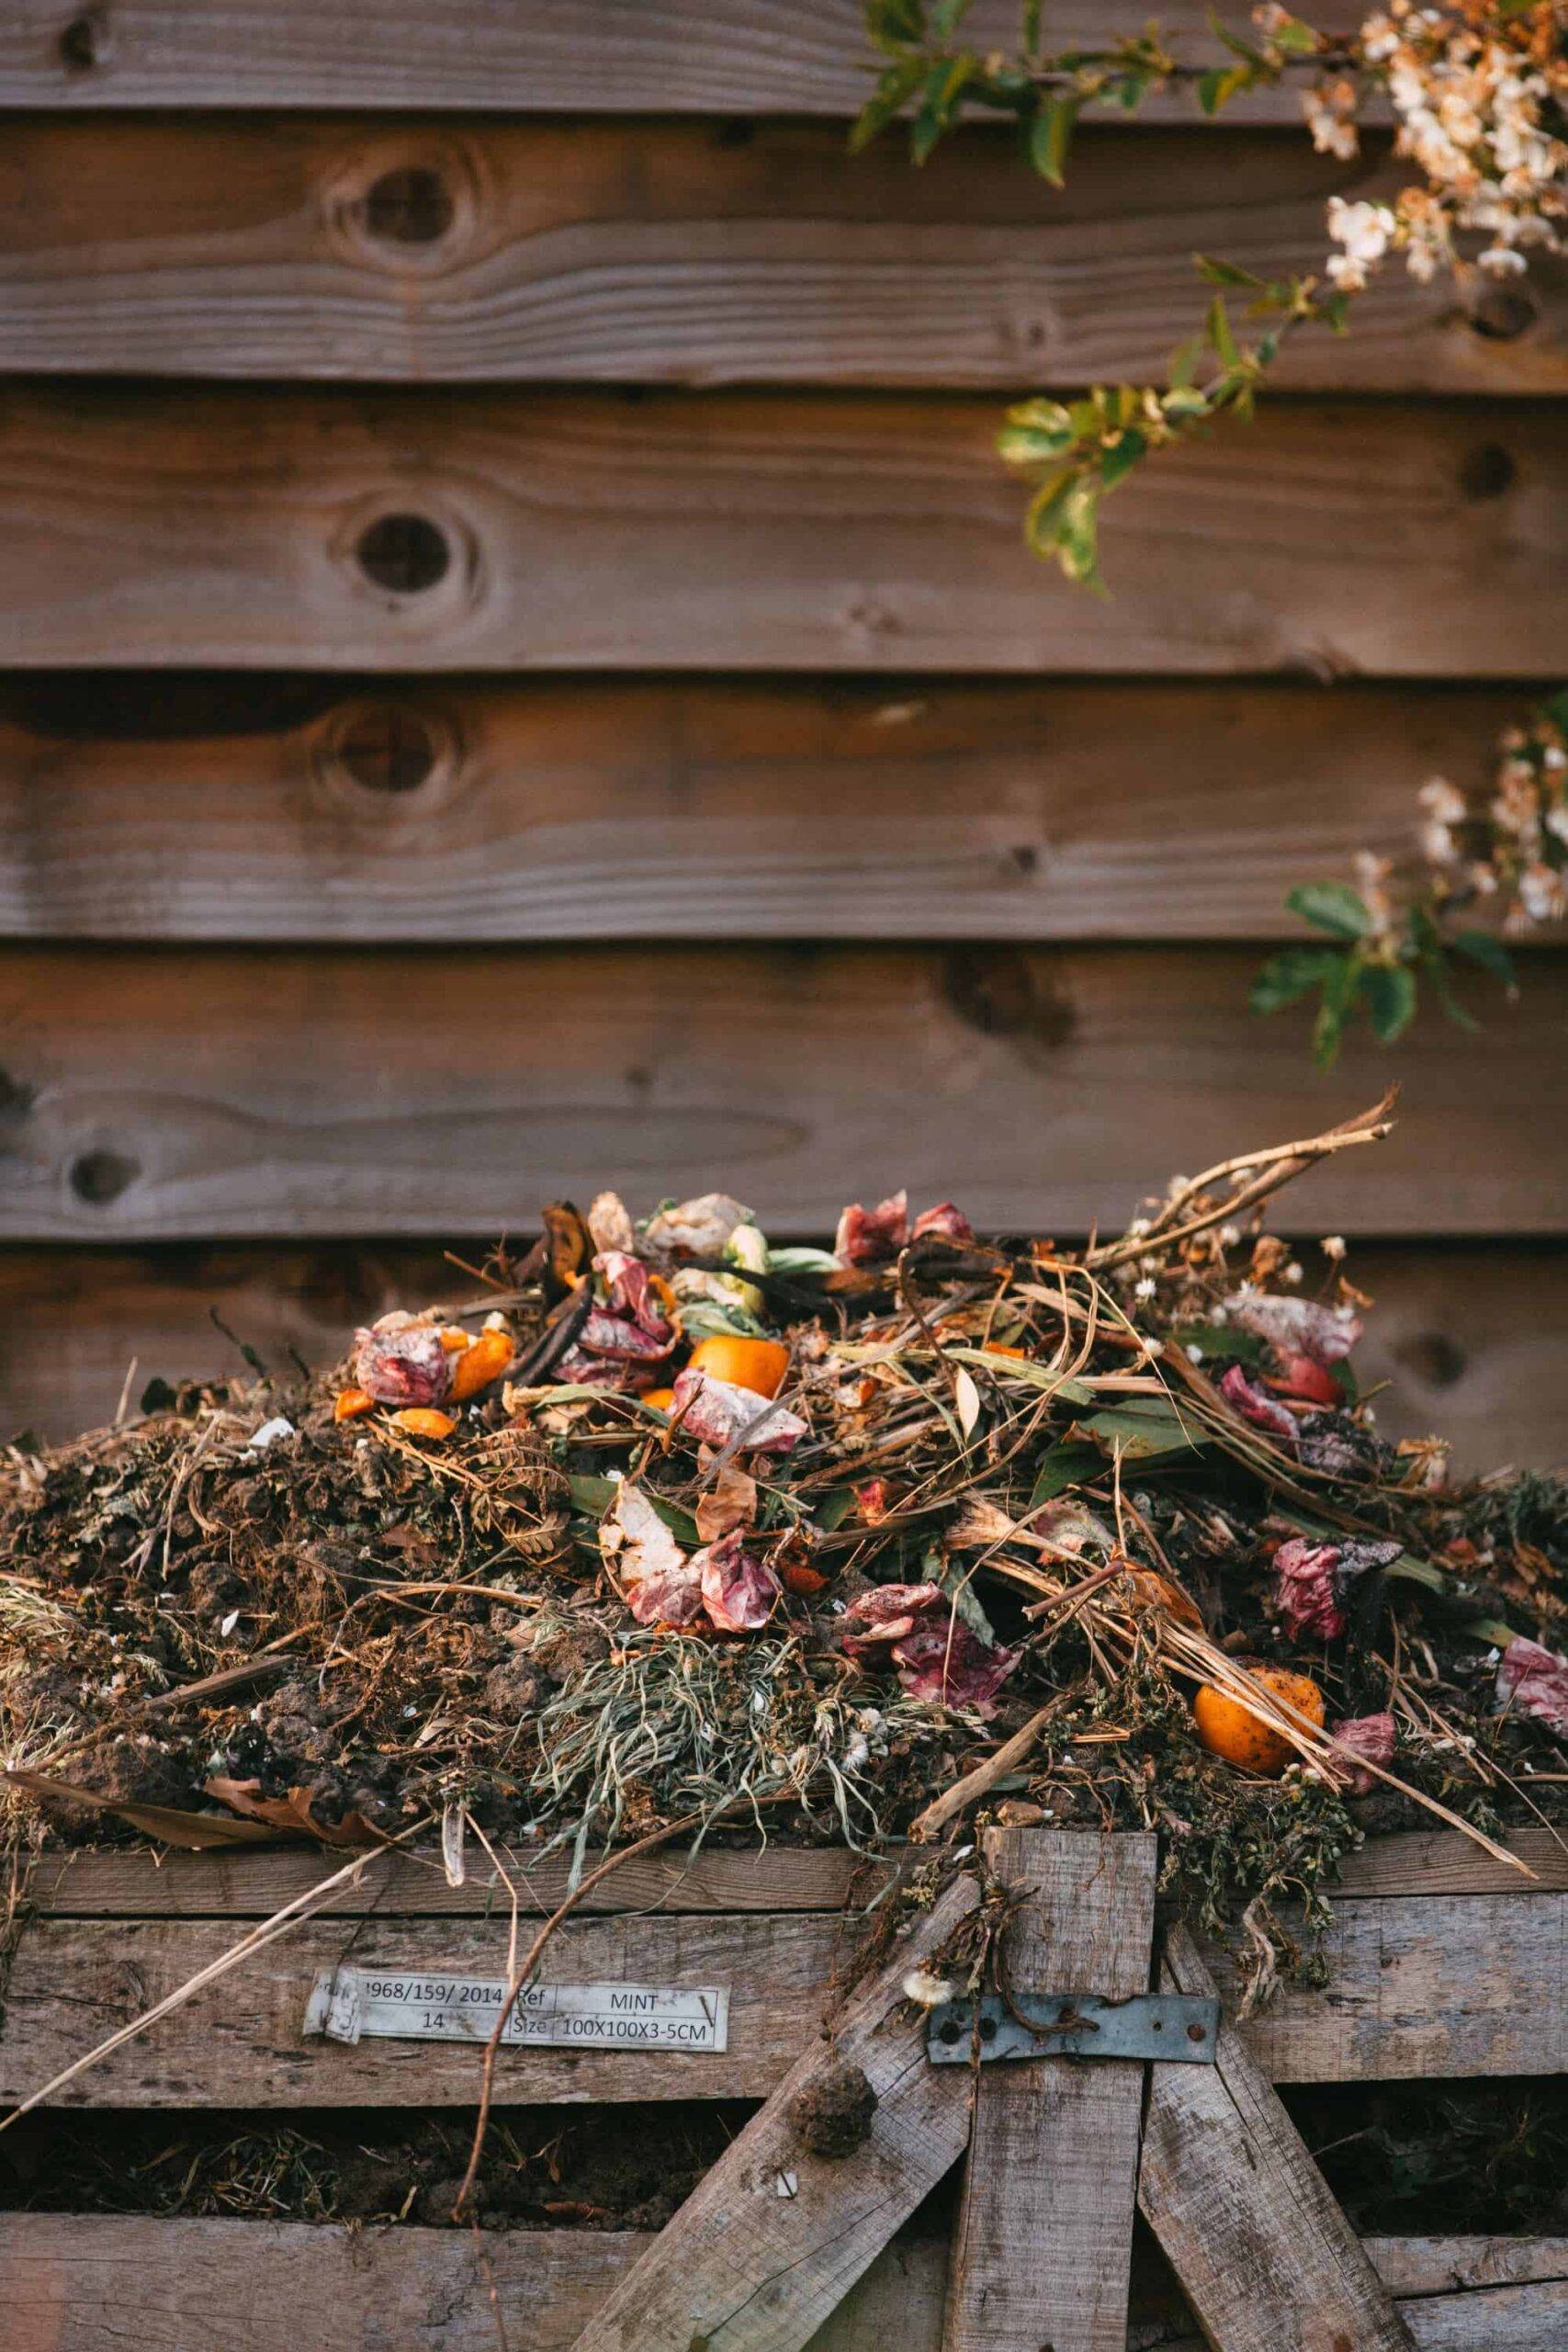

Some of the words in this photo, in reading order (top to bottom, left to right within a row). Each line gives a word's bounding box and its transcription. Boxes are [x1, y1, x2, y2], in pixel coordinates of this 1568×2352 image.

[459, 1986, 502, 2004] 2014
[518, 1989, 546, 2006] Ref
[610, 1993, 659, 2010] MINT
[423, 2012, 444, 2028] 14
[513, 2017, 547, 2034] Size
[564, 2018, 706, 2041] 100X100X3-5CM
